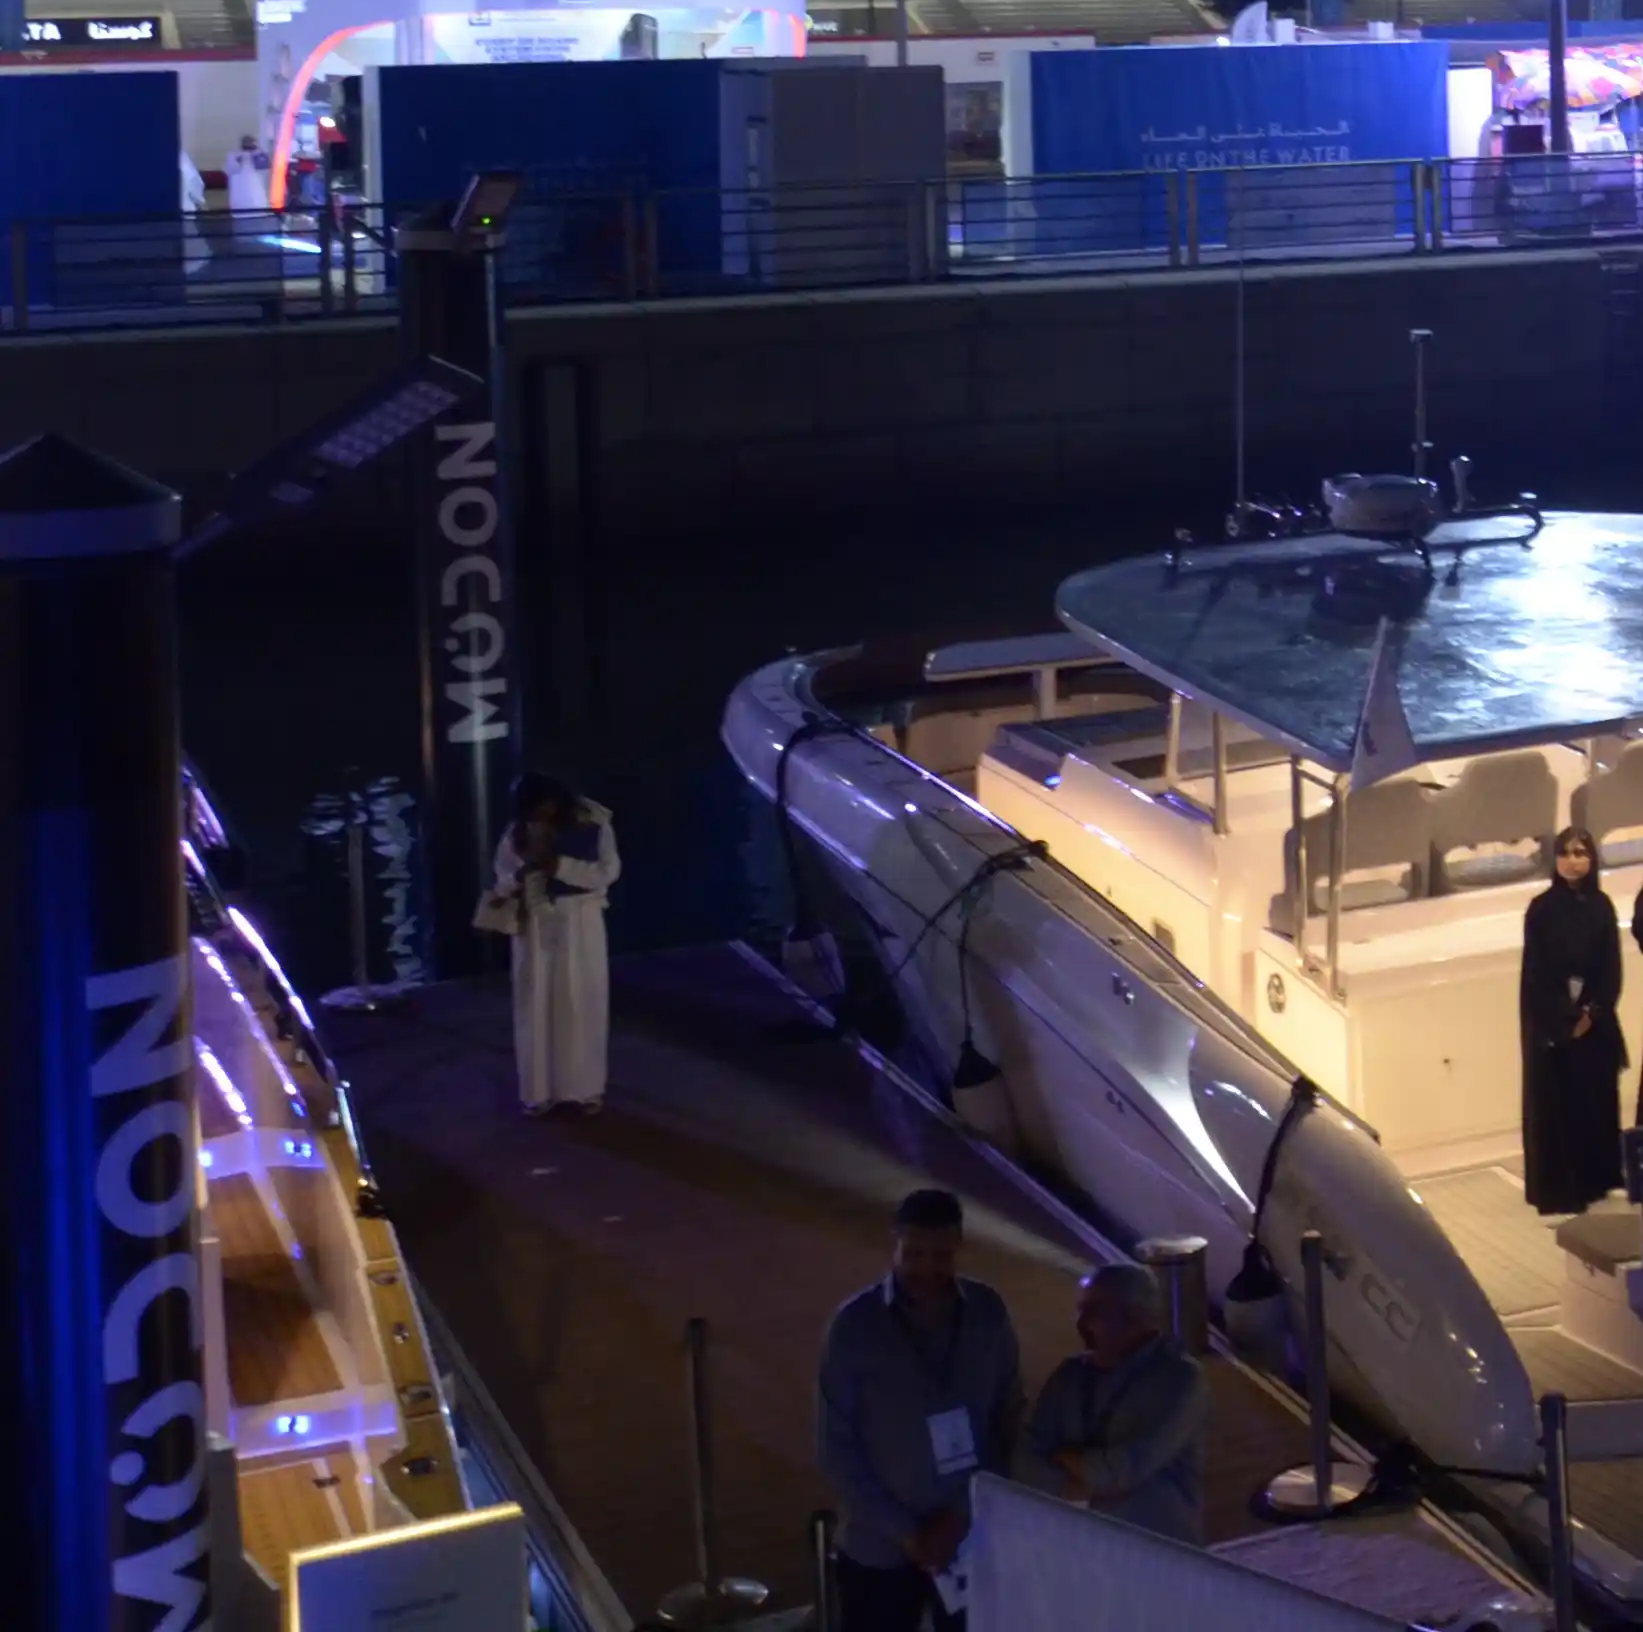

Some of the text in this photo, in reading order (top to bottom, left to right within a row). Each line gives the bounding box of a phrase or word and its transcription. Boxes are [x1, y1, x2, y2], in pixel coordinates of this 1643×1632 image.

[1142, 144, 1351, 170] LIFE ON THE WATER
